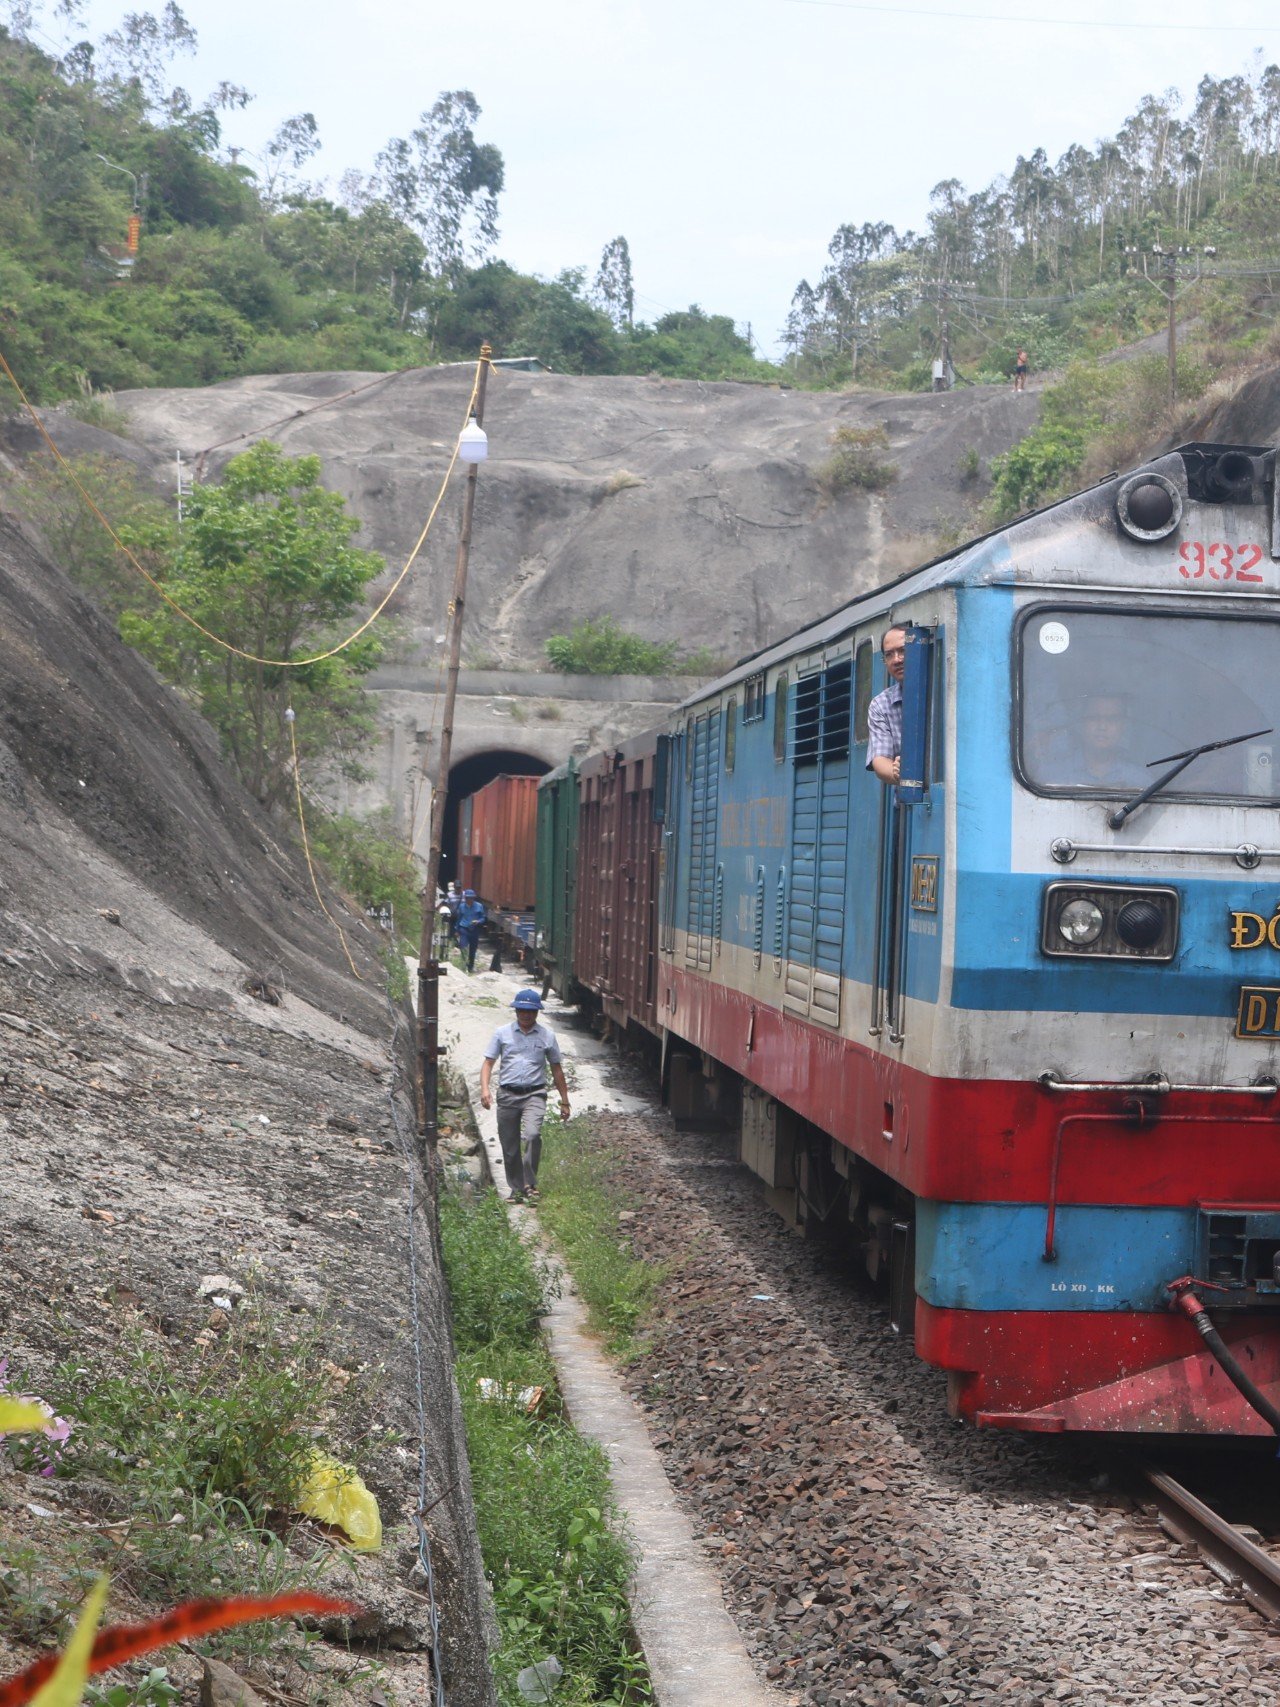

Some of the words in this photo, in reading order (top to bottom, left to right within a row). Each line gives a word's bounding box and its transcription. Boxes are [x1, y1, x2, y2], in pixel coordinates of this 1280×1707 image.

[1179, 541, 1263, 582] 932
[1071, 1284, 1087, 1292] XO
[1098, 1285, 1114, 1293] KK
